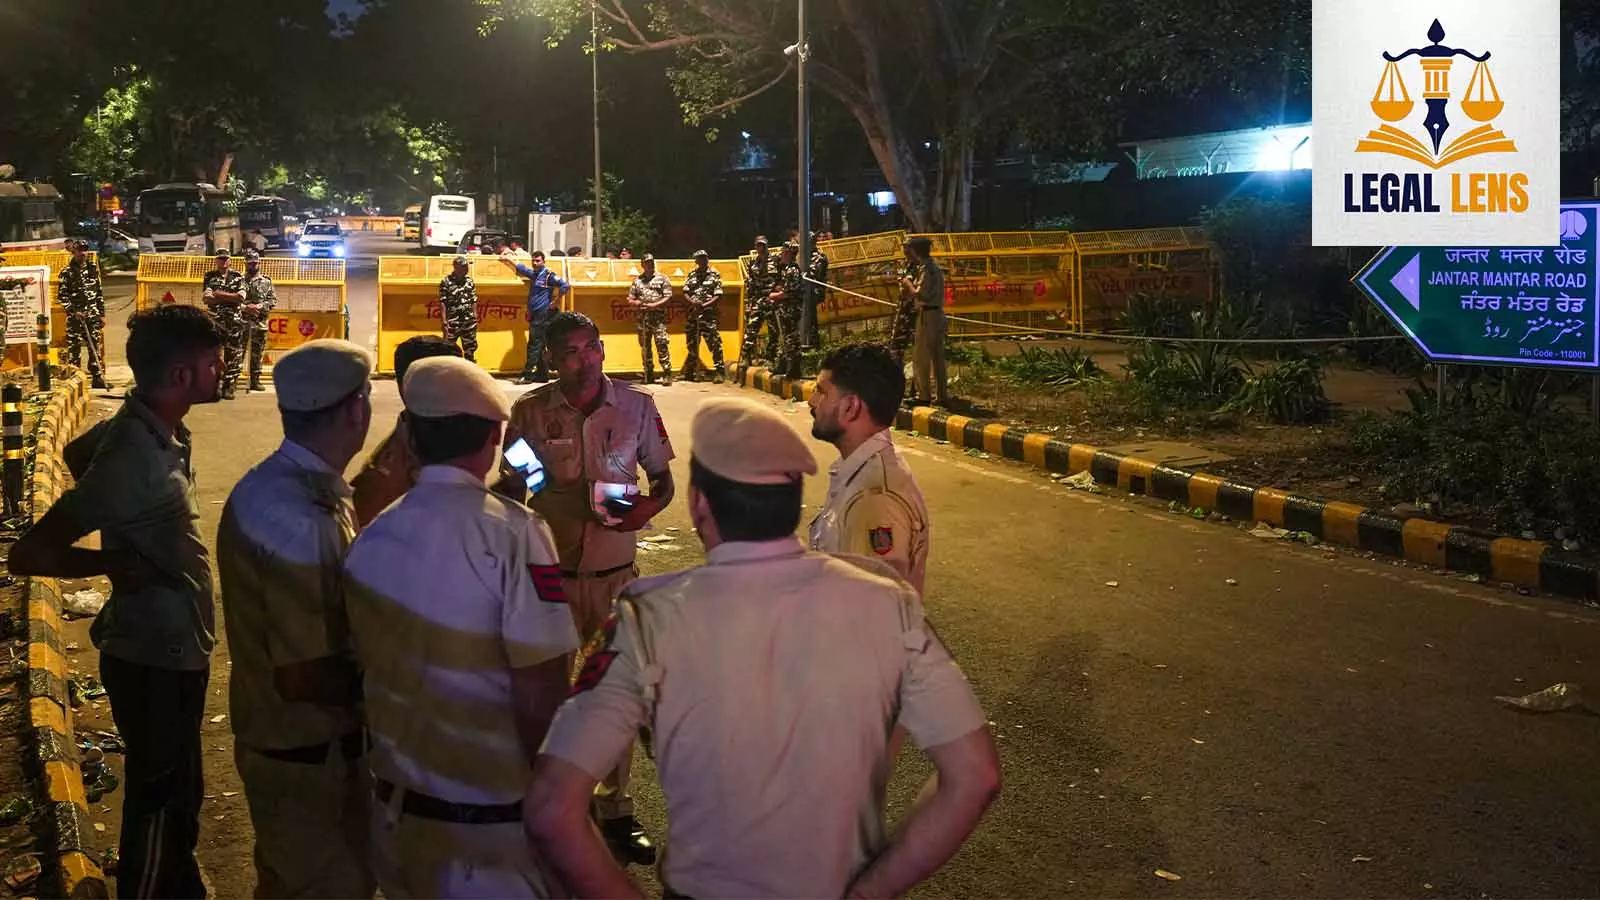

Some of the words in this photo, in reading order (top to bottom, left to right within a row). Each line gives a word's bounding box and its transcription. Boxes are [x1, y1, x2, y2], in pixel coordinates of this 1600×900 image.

[1444, 249, 1490, 264] जन्तर
[1500, 249, 1544, 264] मन्तर
[1554, 244, 1587, 264] रोड
[1428, 271, 1479, 286] JANTAR
[1483, 272, 1540, 287] MANTAR
[1545, 273, 1587, 288] ROAD
[1460, 290, 1502, 310] ਜੰਤਰ
[1507, 291, 1550, 312] ਮੰਤਰ
[1556, 292, 1587, 313] ਰੋਡ
[1519, 348, 1532, 357] Pin
[1533, 348, 1553, 357] Code
